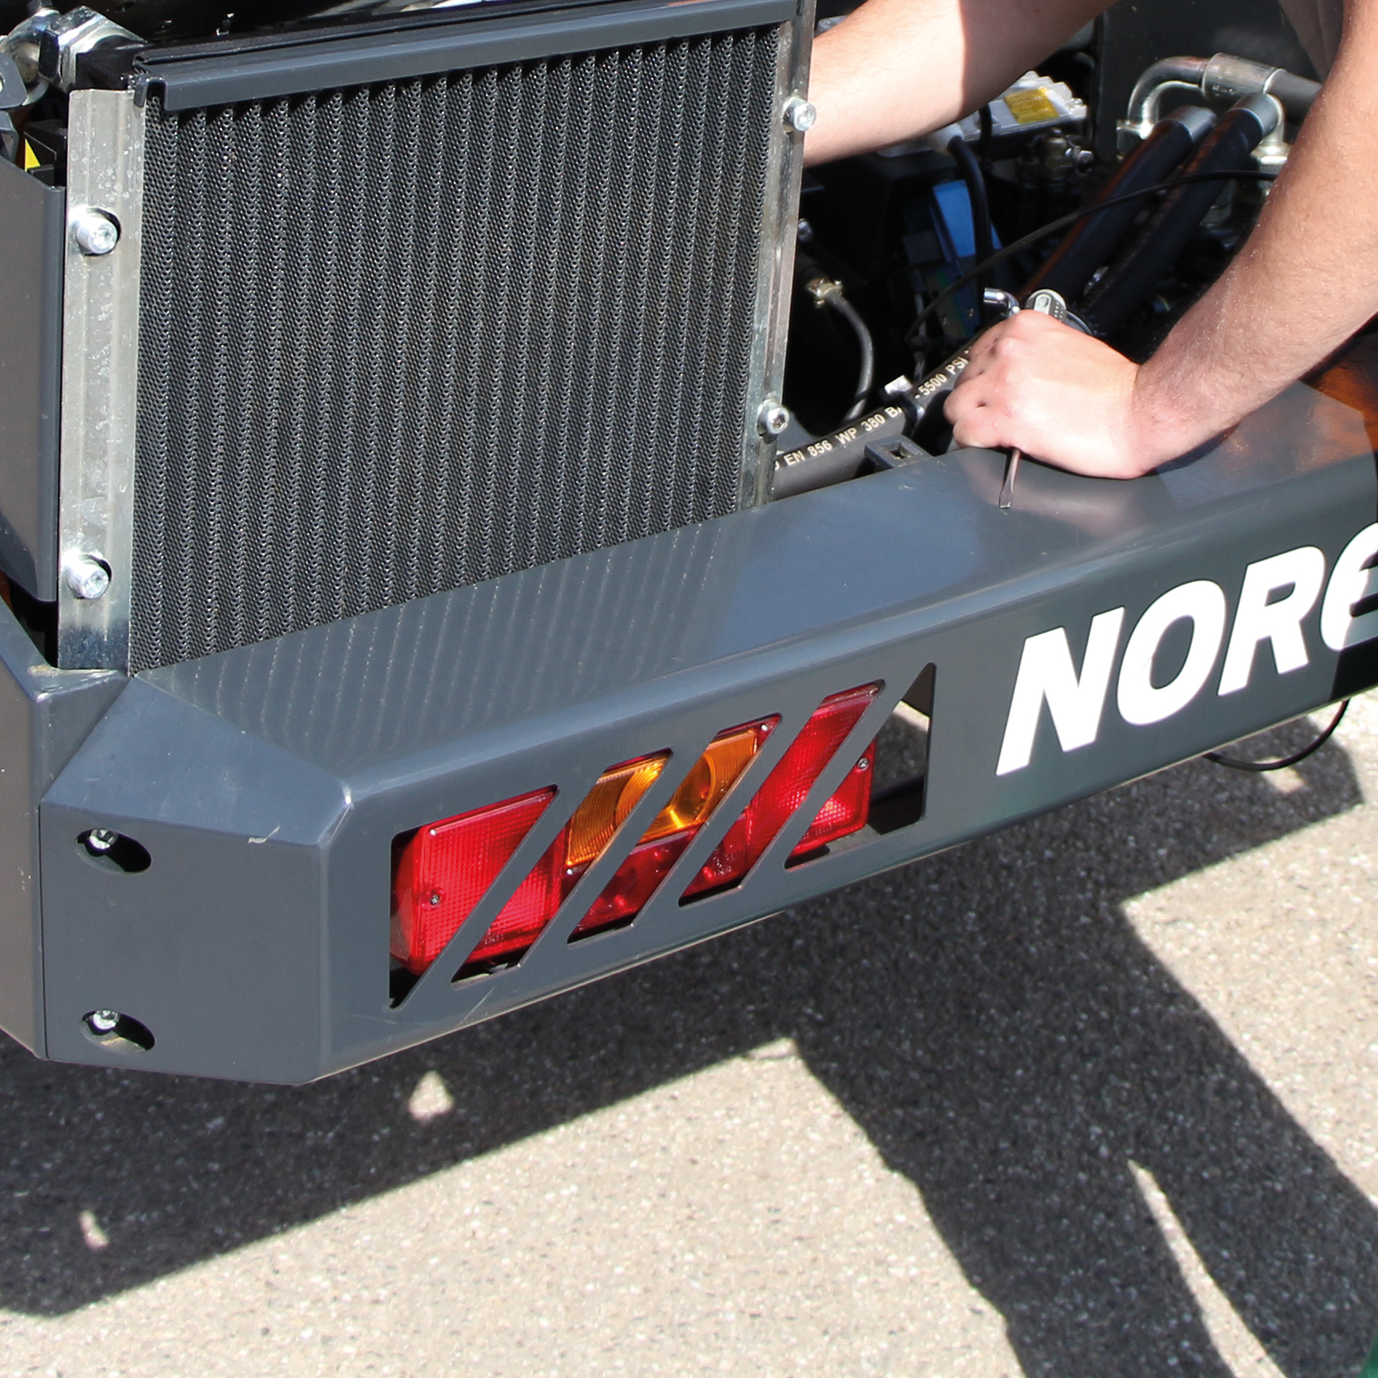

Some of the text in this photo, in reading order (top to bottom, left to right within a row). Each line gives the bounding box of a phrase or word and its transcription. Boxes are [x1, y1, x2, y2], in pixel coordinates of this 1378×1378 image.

[783, 450, 806, 466] EN
[807, 439, 833, 457] 856
[834, 426, 858, 446] WP
[860, 413, 886, 432] 380
[918, 373, 948, 397] 5500
[945, 356, 969, 376] PSI
